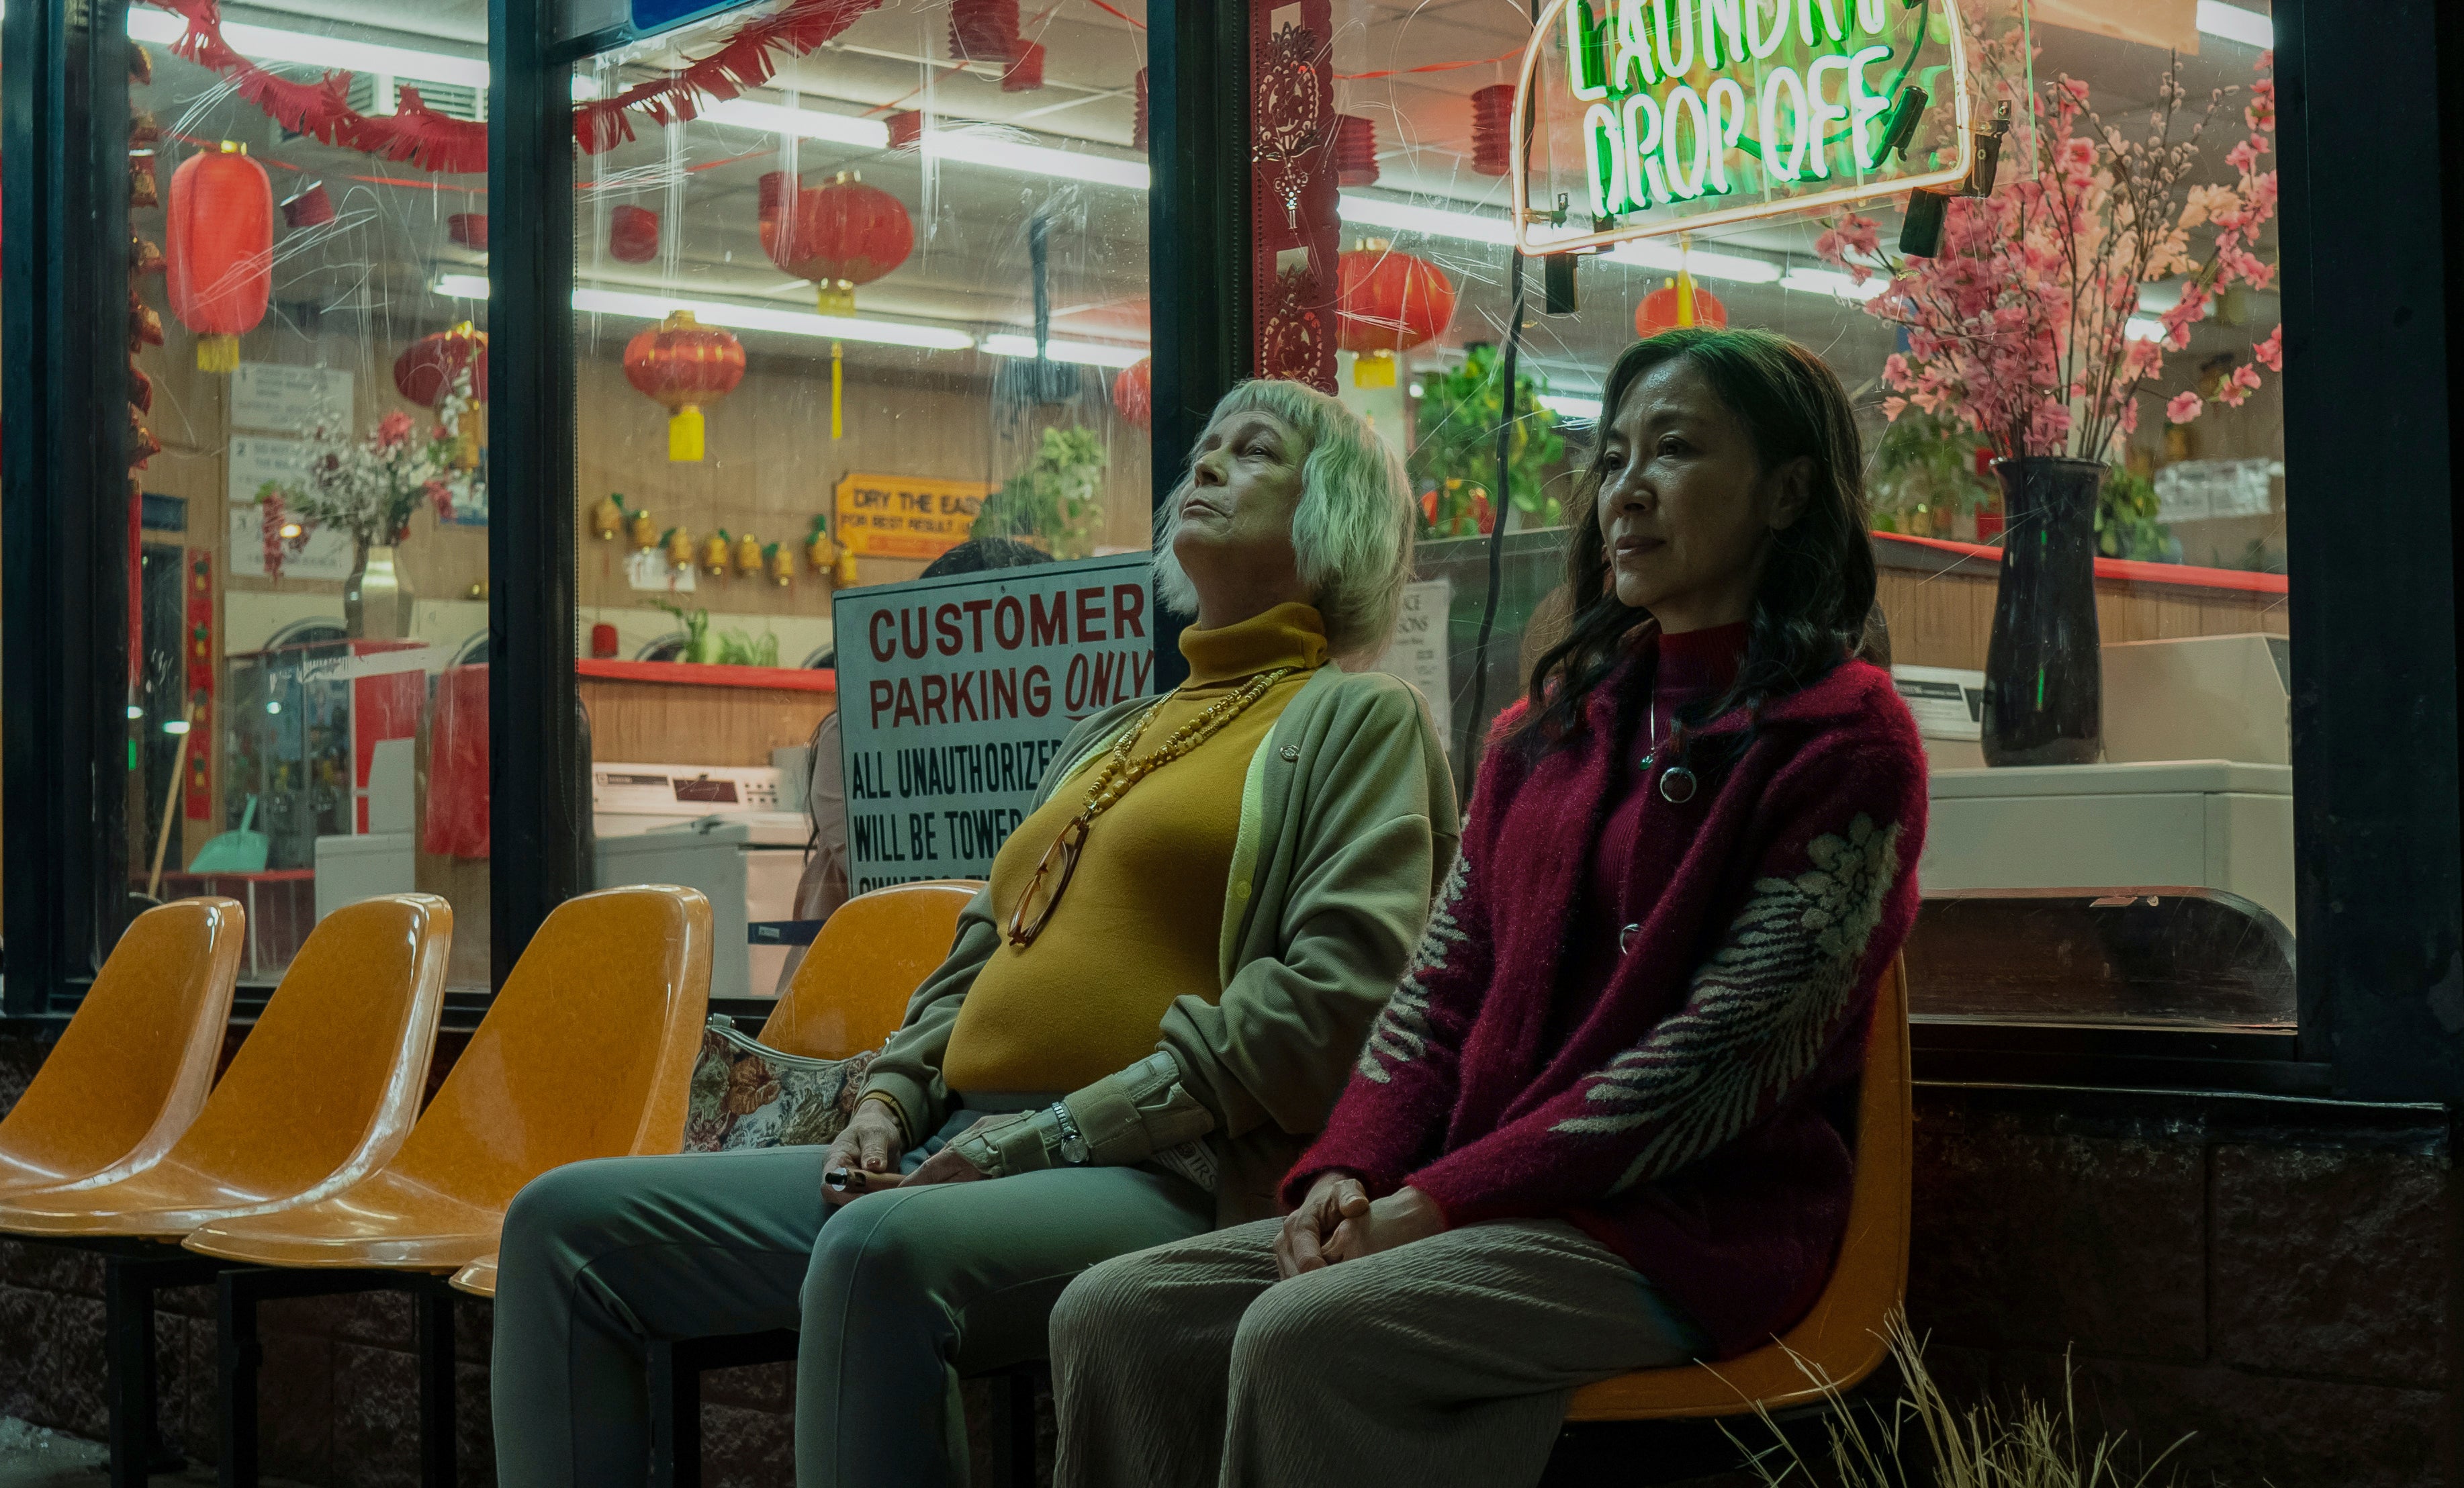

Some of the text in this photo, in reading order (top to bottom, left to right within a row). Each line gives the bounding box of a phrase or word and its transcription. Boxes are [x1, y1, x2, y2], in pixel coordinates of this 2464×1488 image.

[1583, 45, 1894, 218] DROP OFF
[854, 488, 891, 508] DRY
[898, 491, 933, 514] THE
[869, 584, 1146, 663] CUSTOMER
[870, 649, 1154, 729] PARKING ONLY
[852, 751, 891, 800] ALL
[853, 813, 905, 862] WILL
[910, 811, 938, 862] BE
[1189, 1157, 1217, 1189] IRS
